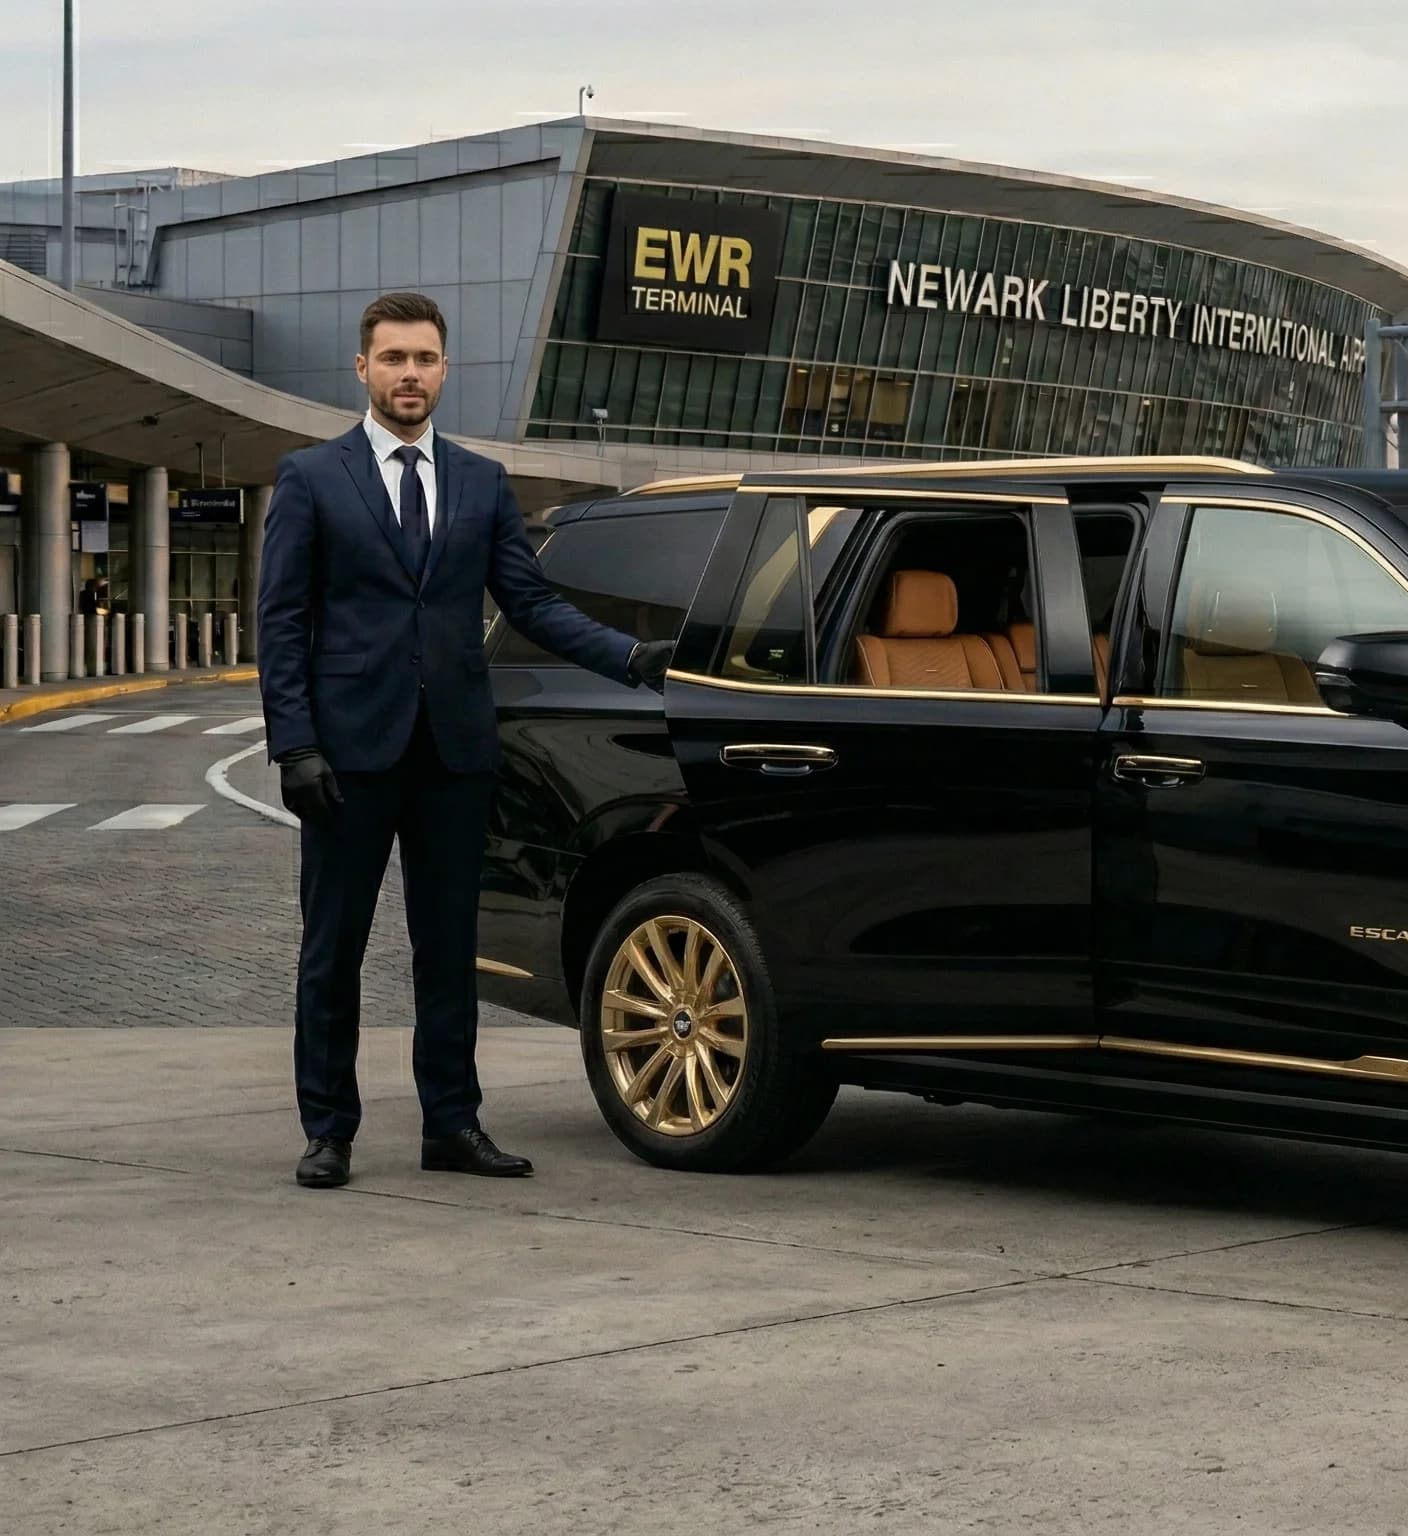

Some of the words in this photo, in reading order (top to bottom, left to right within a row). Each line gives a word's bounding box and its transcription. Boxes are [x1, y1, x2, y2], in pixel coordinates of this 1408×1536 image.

[634, 226, 753, 289] EWR
[631, 286, 748, 319] TERMINAL
[887, 260, 1049, 321] NEWARK
[1061, 284, 1183, 339] LIBERTY
[1191, 303, 1336, 368] INTERNATIONAL
